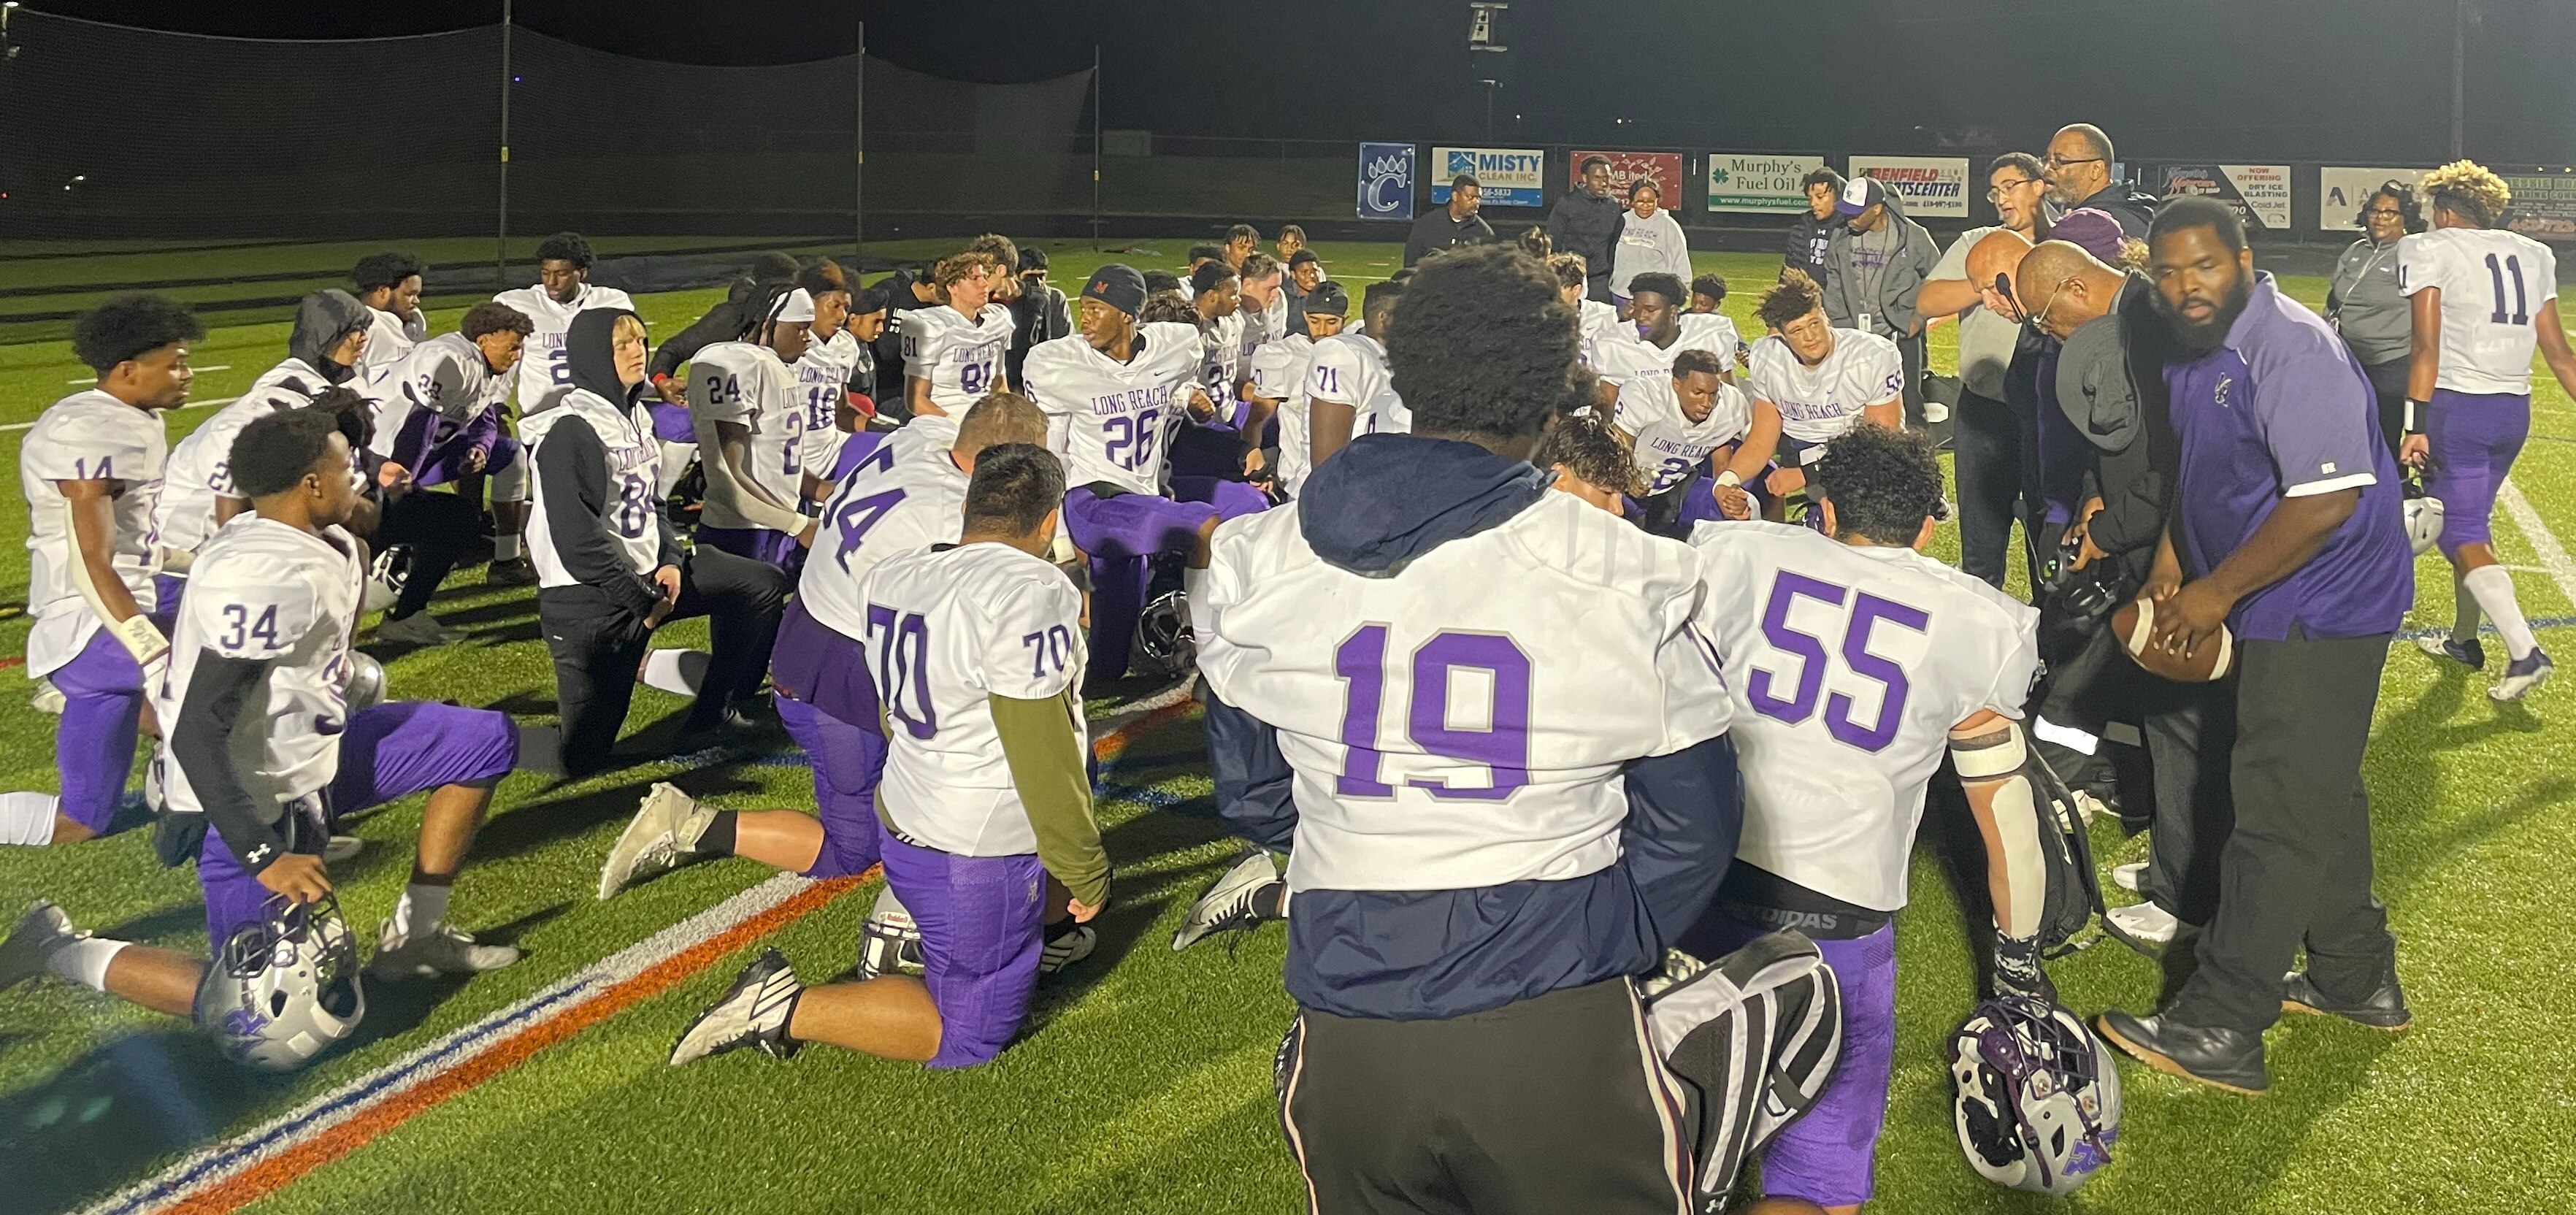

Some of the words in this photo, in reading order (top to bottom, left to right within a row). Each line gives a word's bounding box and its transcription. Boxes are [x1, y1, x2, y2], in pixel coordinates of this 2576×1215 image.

[1479, 153, 1541, 172] MISTY
[1731, 158, 1802, 175] Murphy's
[1870, 167, 1940, 182] BENFIELD
[1479, 171, 1513, 182] CLEAN
[1516, 172, 1538, 183] INC.
[1736, 176, 1768, 190] Fuel
[1774, 177, 1795, 191] Oil
[2485, 253, 2529, 326] 11
[904, 336, 918, 357] 81
[952, 346, 975, 363] LONG
[707, 373, 741, 405] 24
[961, 361, 992, 394] 81
[1317, 366, 1338, 393] 71
[1092, 393, 1126, 415] LONG
[1129, 386, 1168, 410] REACH
[1779, 399, 1804, 419] LONG
[1805, 402, 1844, 420] REACH
[1103, 409, 1159, 472] 26
[1650, 437, 1681, 455] LONG
[75, 455, 112, 480] 14
[221, 603, 277, 651] 34
[1022, 624, 1071, 680] 70
[1746, 567, 1933, 755] 55
[867, 602, 938, 741] 70
[1332, 620, 1536, 805] 19
